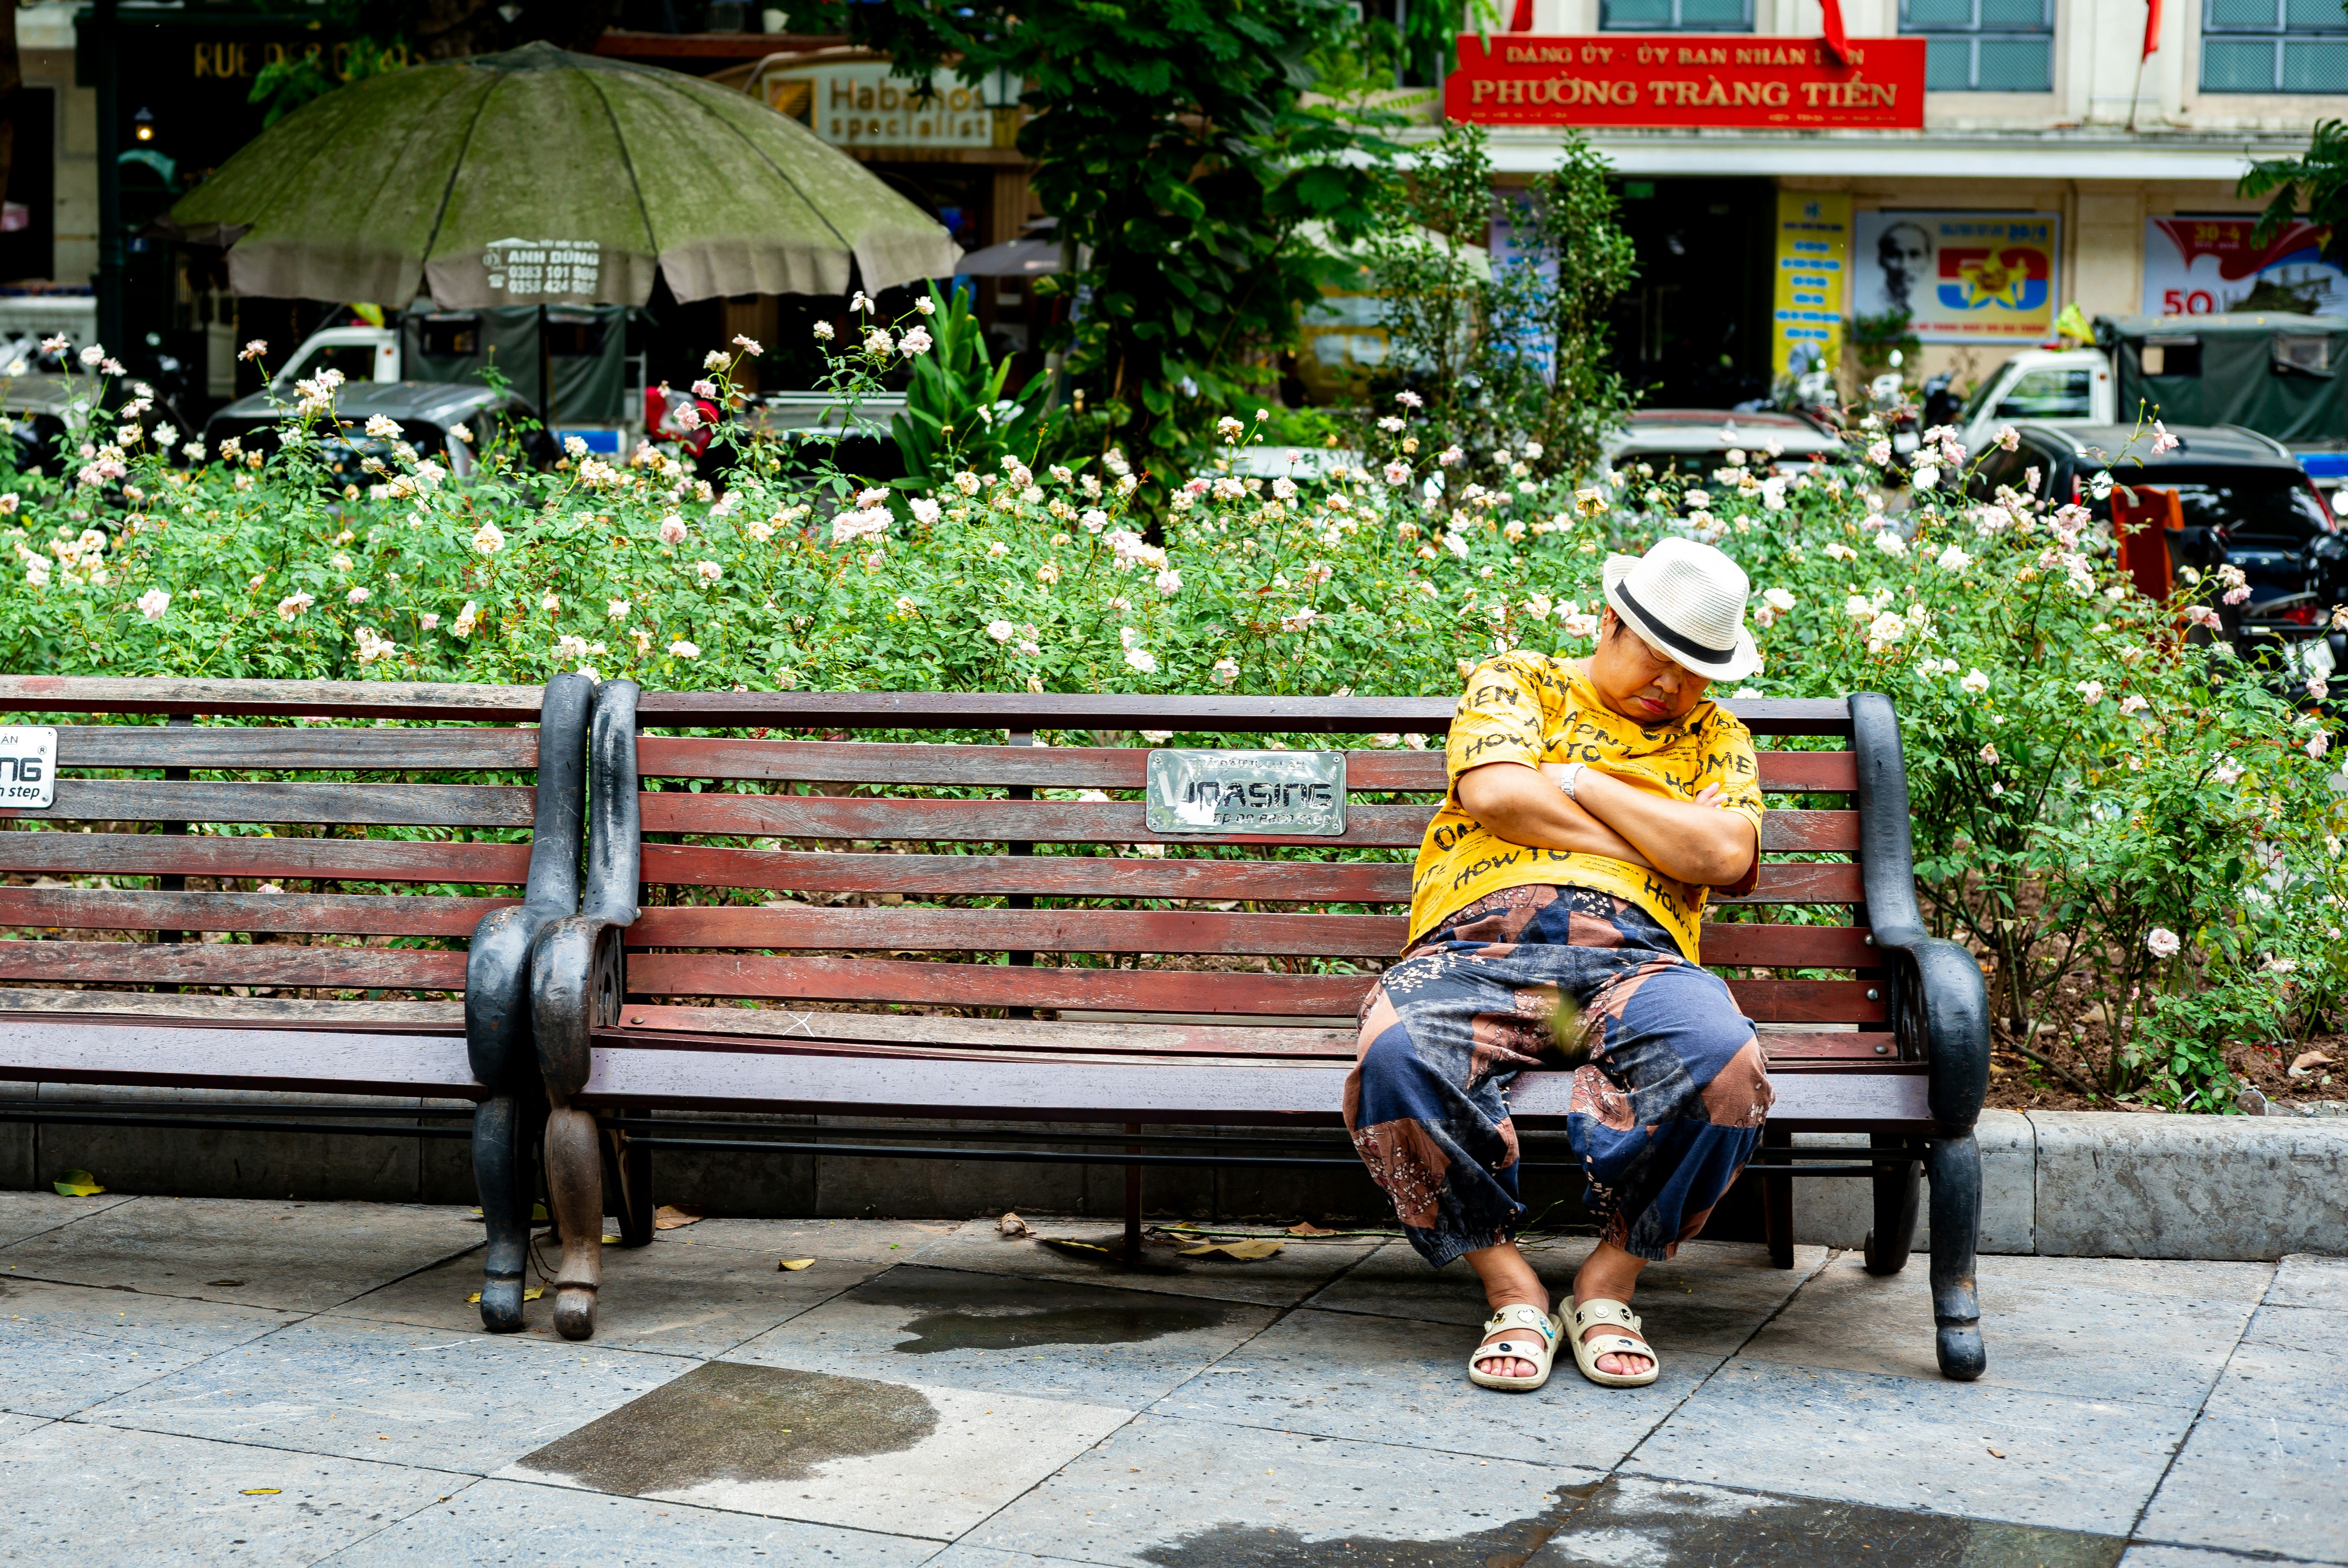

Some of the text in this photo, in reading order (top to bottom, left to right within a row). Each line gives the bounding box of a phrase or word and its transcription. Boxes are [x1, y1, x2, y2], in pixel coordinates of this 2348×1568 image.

[195, 42, 252, 79] RUE
[1677, 47, 1727, 65] BAN
[1647, 74, 1791, 107] TRÀNG
[830, 112, 986, 142] specialist
[507, 250, 546, 264] ANH
[546, 265, 570, 279] 101
[543, 279, 569, 294] 424
[2163, 288, 2215, 316] 50
[8, 786, 40, 800] step
